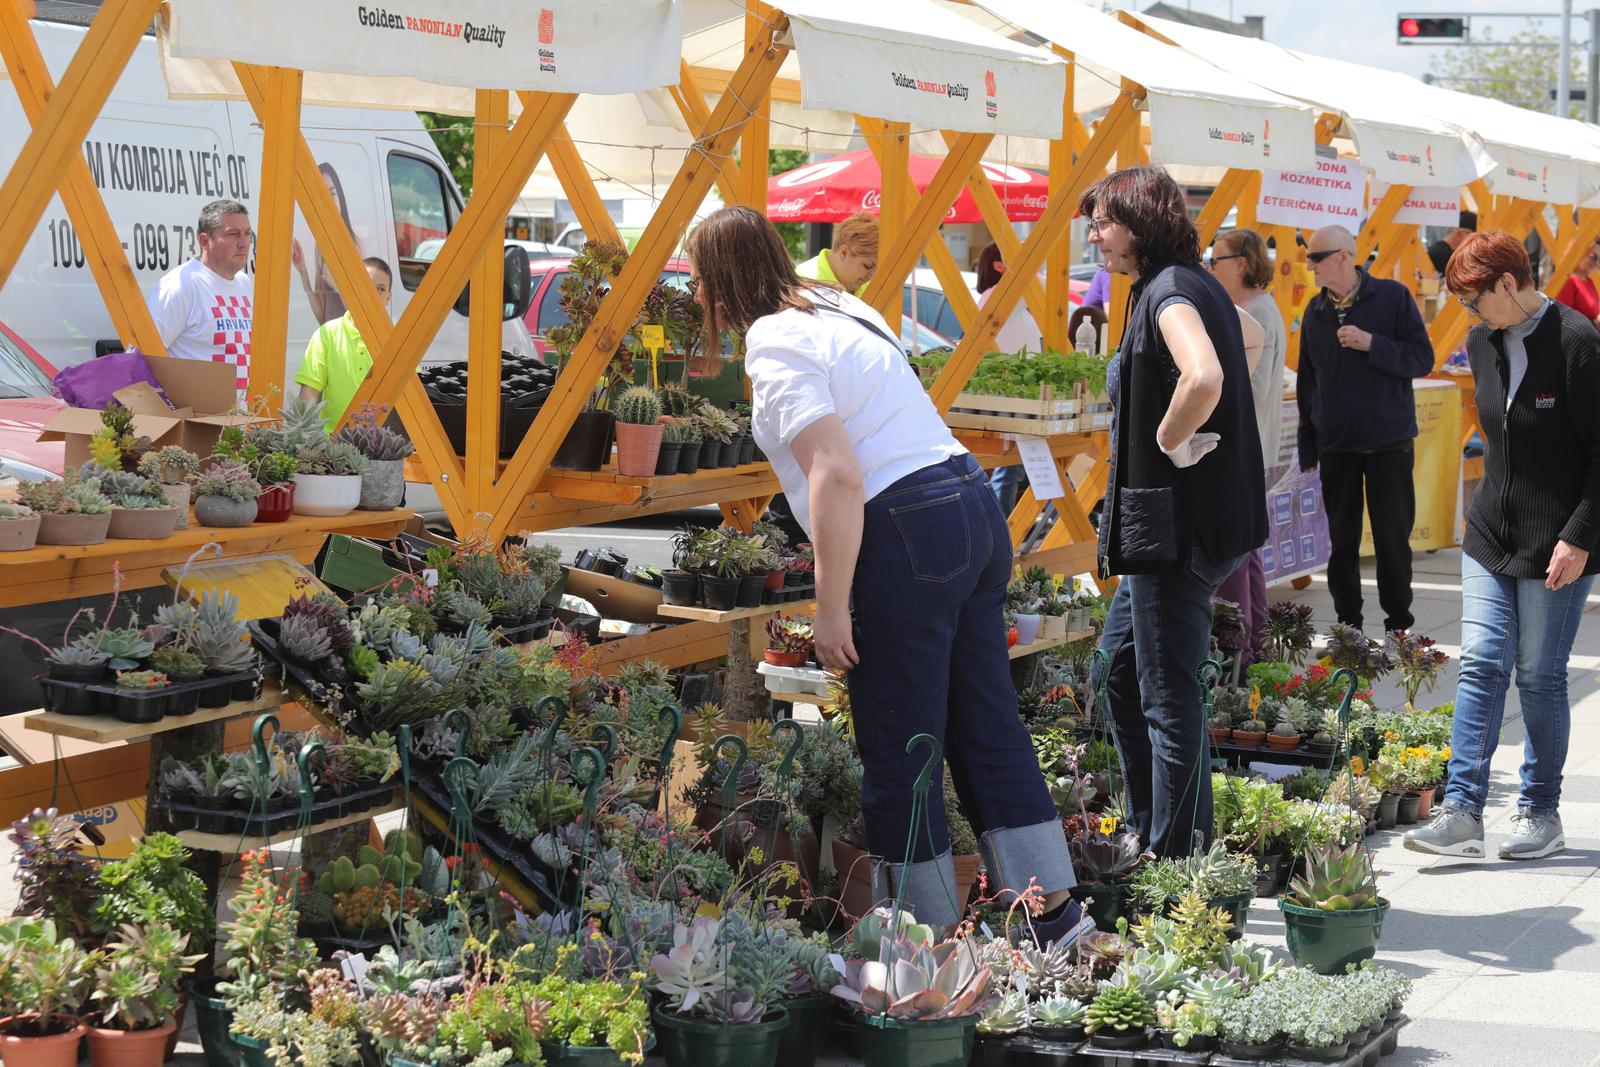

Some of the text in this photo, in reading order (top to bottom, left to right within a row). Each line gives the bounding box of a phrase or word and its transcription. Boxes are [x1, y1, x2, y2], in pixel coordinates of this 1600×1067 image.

[358, 6, 506, 48] Golden PANONIAN Quality
[892, 72, 917, 90] Golden
[947, 82, 969, 101] Quality
[108, 142, 189, 195] KOMBIJA
[189, 144, 224, 198] VEĆ
[1280, 172, 1352, 191] KOZMETIKA
[1263, 195, 1358, 217] ETERIČNA ULJA
[1430, 201, 1457, 211] ULJA
[133, 222, 169, 271] 099
